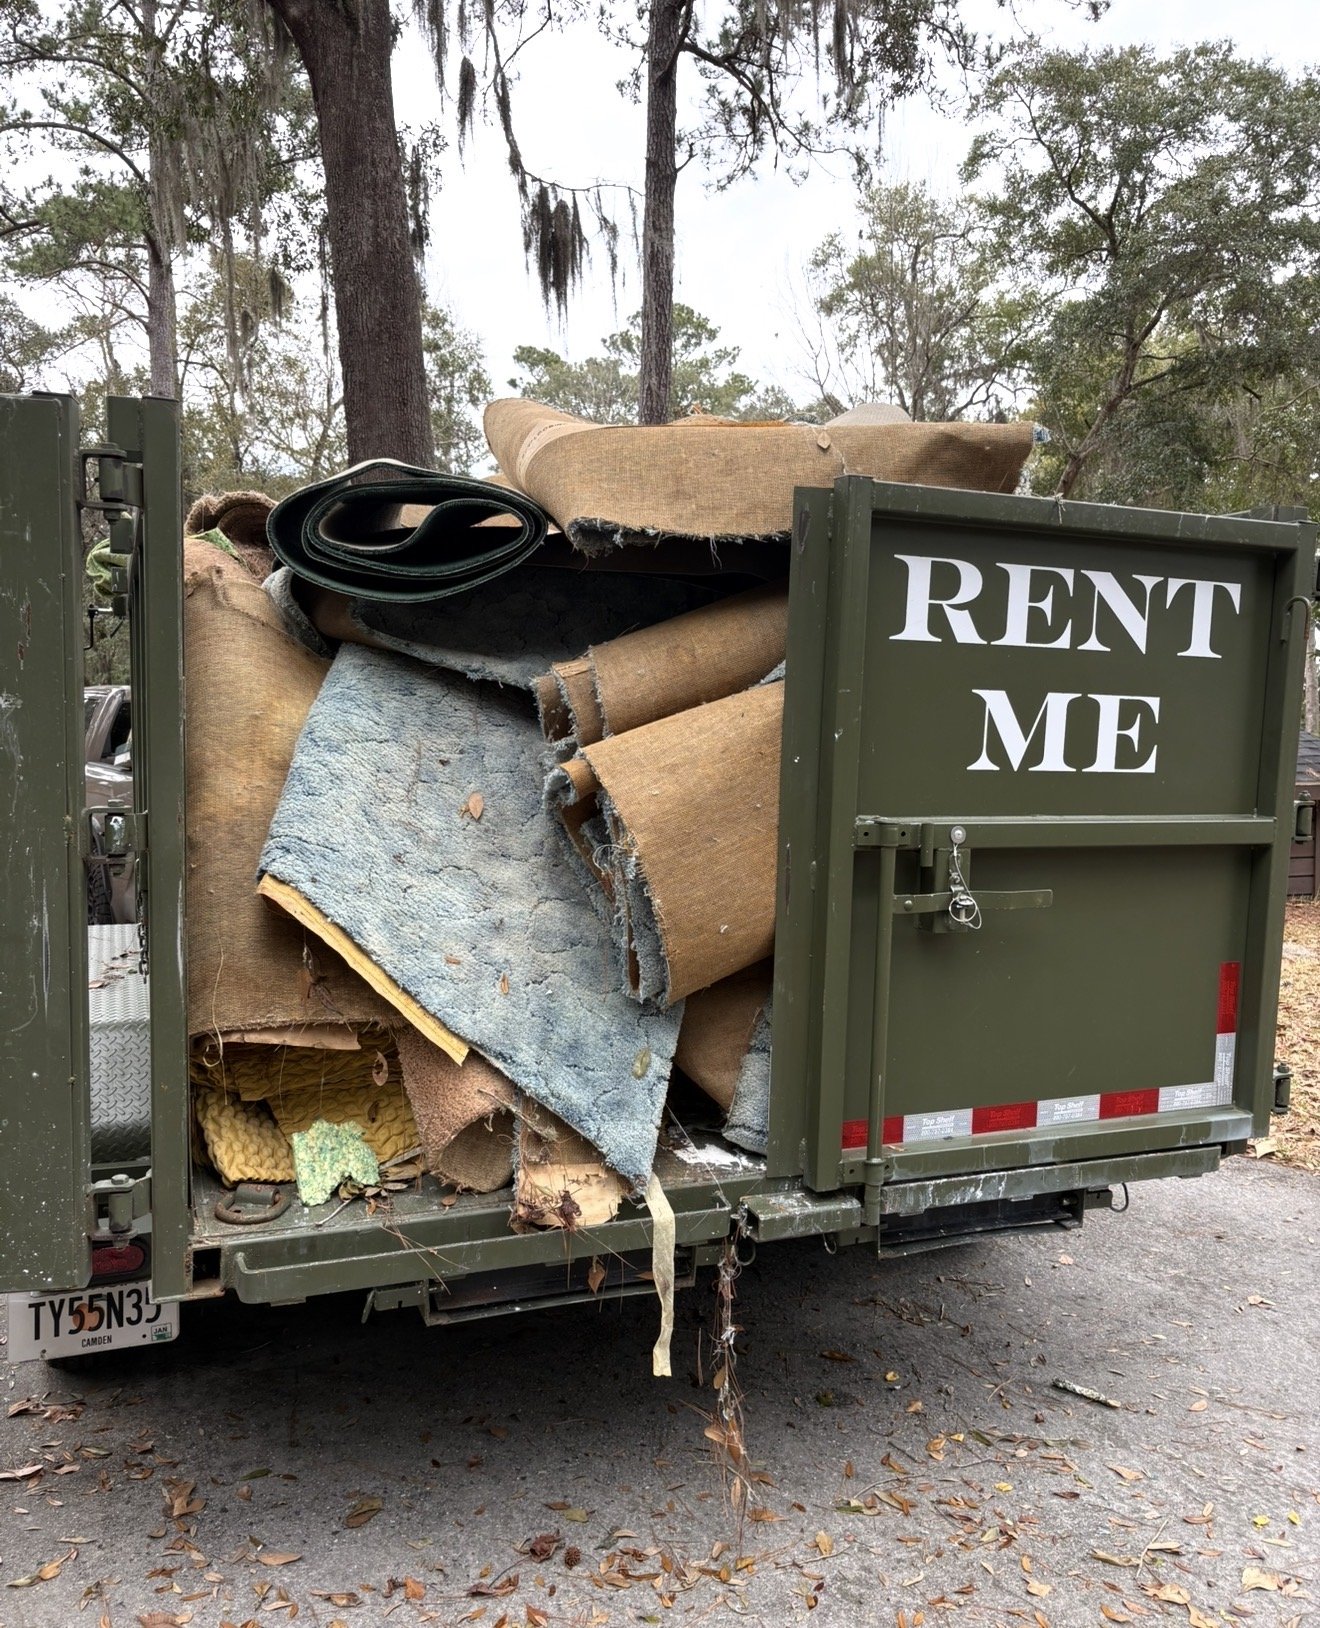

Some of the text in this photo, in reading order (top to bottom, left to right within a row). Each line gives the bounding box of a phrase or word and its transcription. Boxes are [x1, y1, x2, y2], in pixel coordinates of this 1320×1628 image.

[888, 553, 1242, 659] RENT
[966, 688, 1161, 774] ME
[1054, 1100, 1085, 1113] Top Shelf
[922, 1114, 956, 1128] Top Shelf
[153, 1326, 168, 1334] JAN
[81, 1334, 113, 1348] CAMDEN
